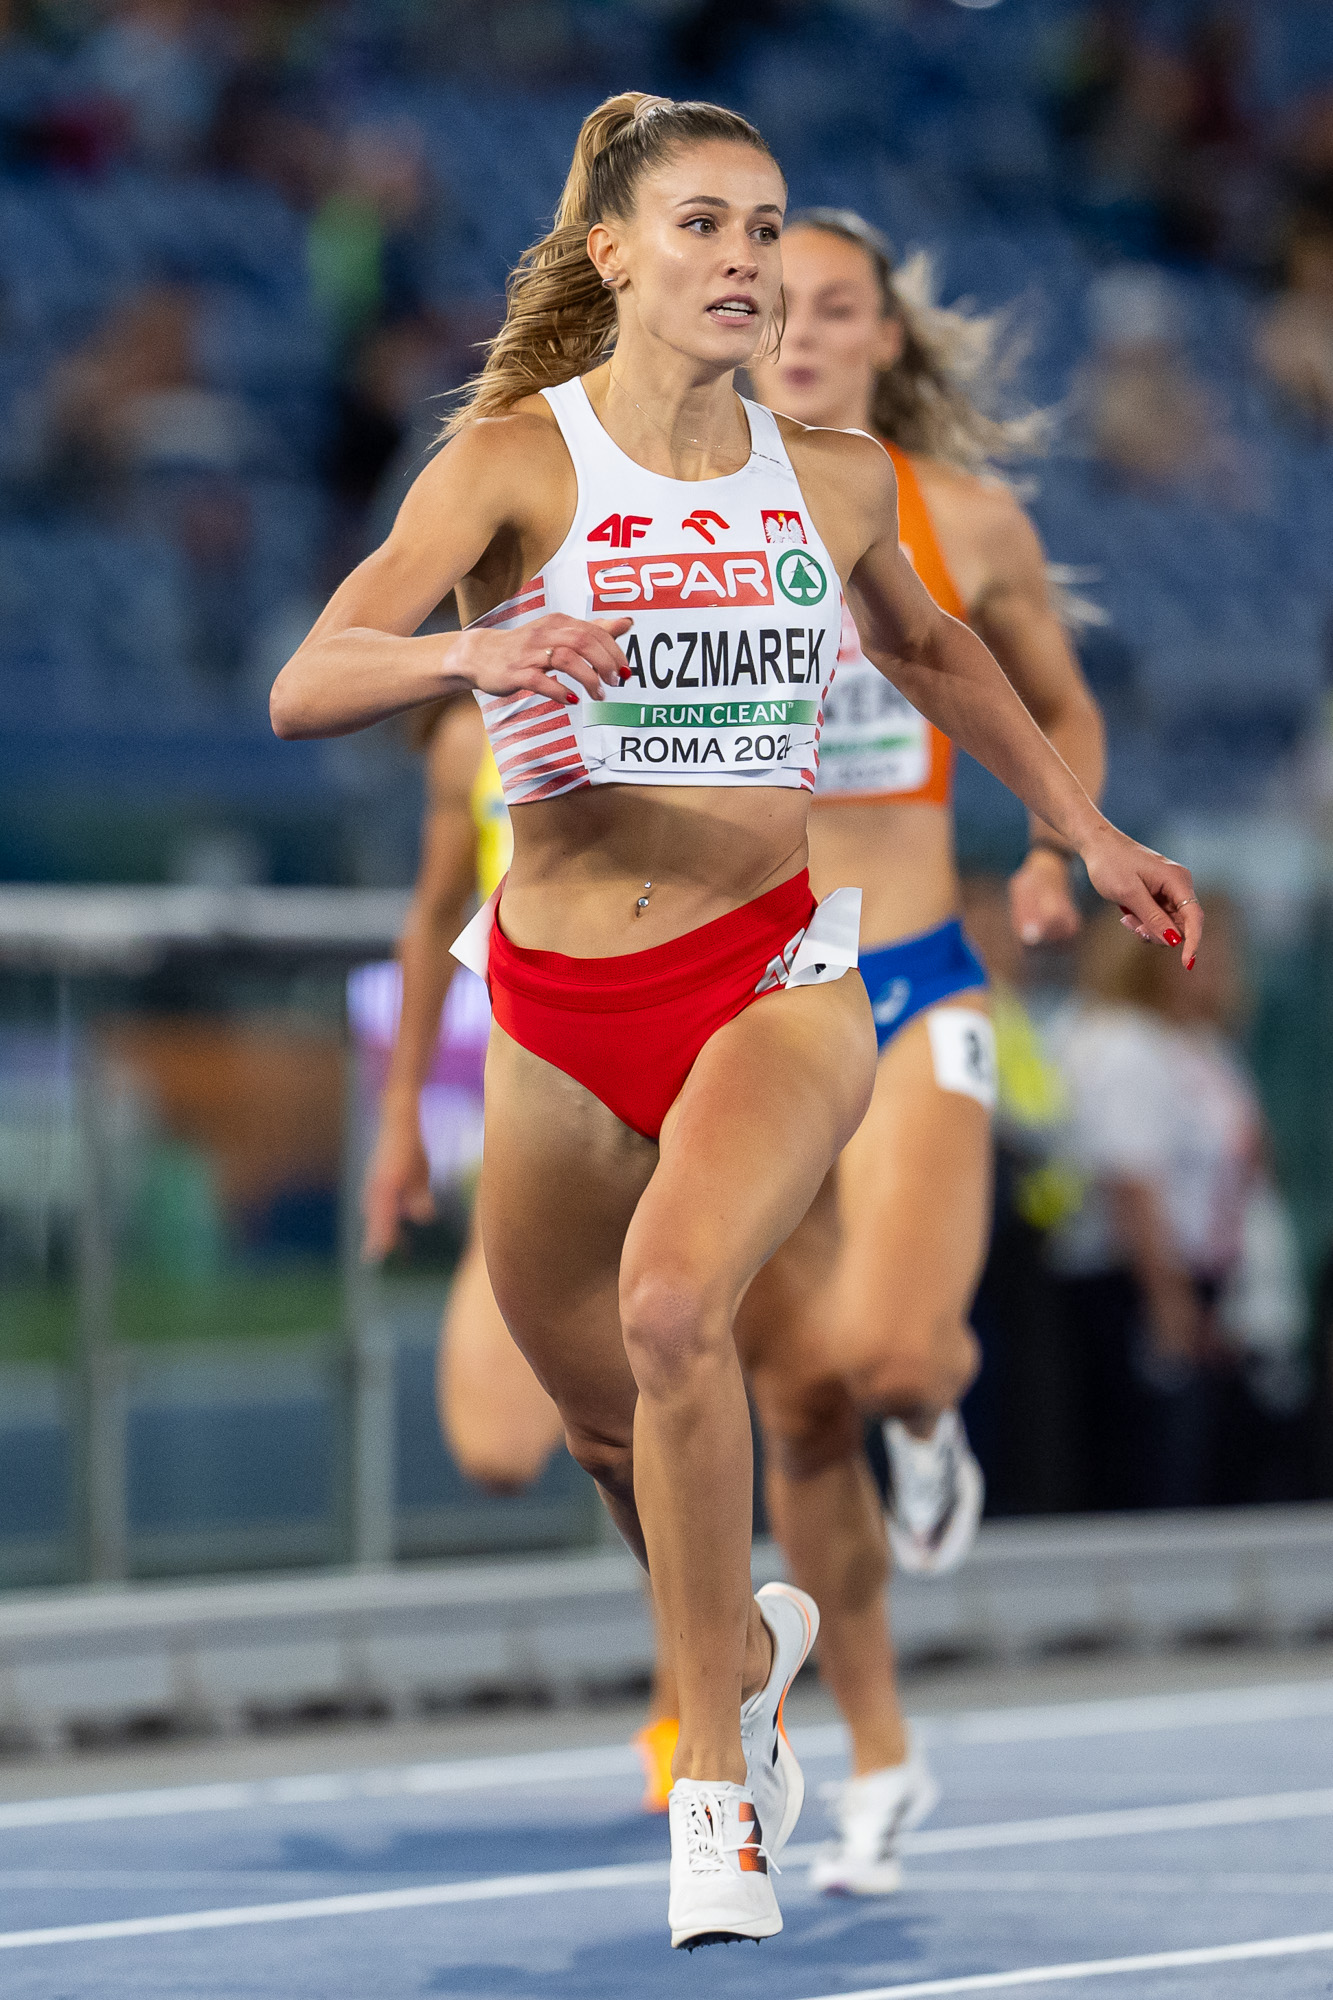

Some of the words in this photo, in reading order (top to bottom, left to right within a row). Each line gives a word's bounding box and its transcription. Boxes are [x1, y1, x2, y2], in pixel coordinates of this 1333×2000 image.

[587, 513, 653, 548] 4F
[594, 558, 769, 603] SPAR
[610, 628, 826, 690] ACZMAREK
[639, 706, 646, 725] I
[651, 706, 704, 725] RUN
[619, 736, 726, 764] ROMA
